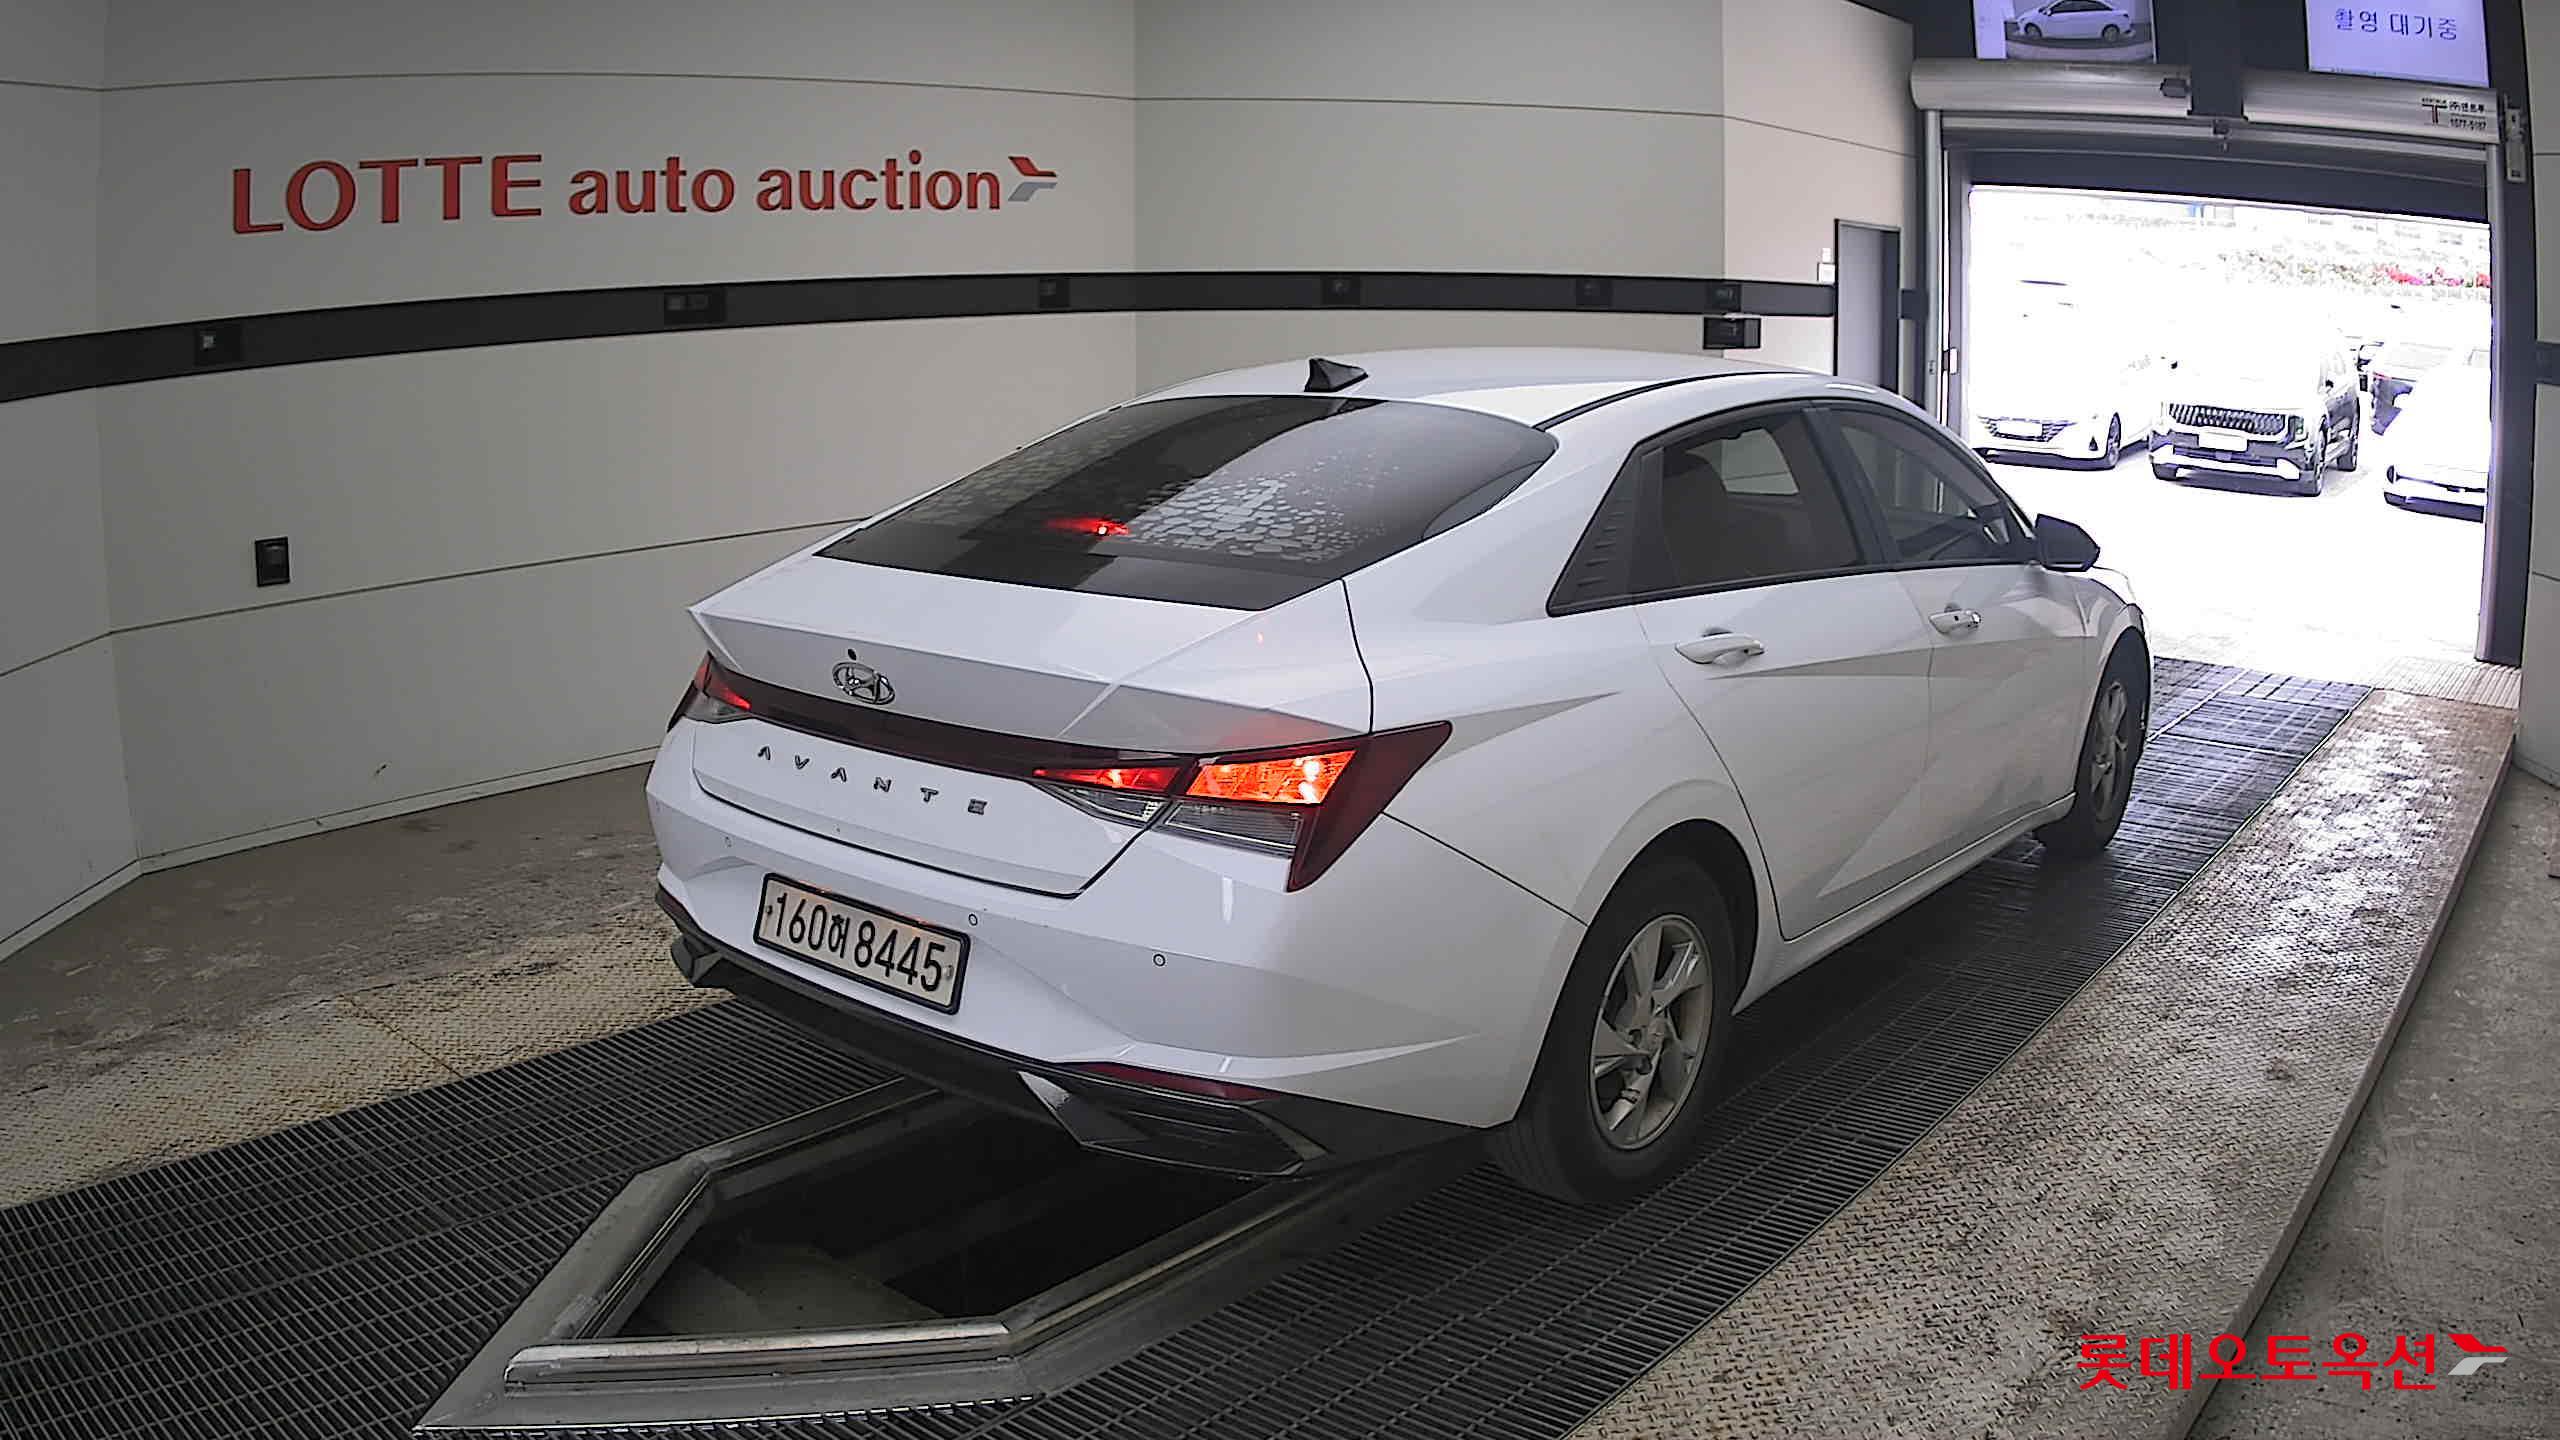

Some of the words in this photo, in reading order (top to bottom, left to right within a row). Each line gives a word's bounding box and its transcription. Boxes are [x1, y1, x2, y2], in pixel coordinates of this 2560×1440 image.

[2390, 13, 2457, 41] 대기중
[233, 154, 542, 234] LOTTE
[568, 156, 736, 215] auto
[756, 149, 1001, 213] auction
[757, 745, 988, 815] AVANTE
